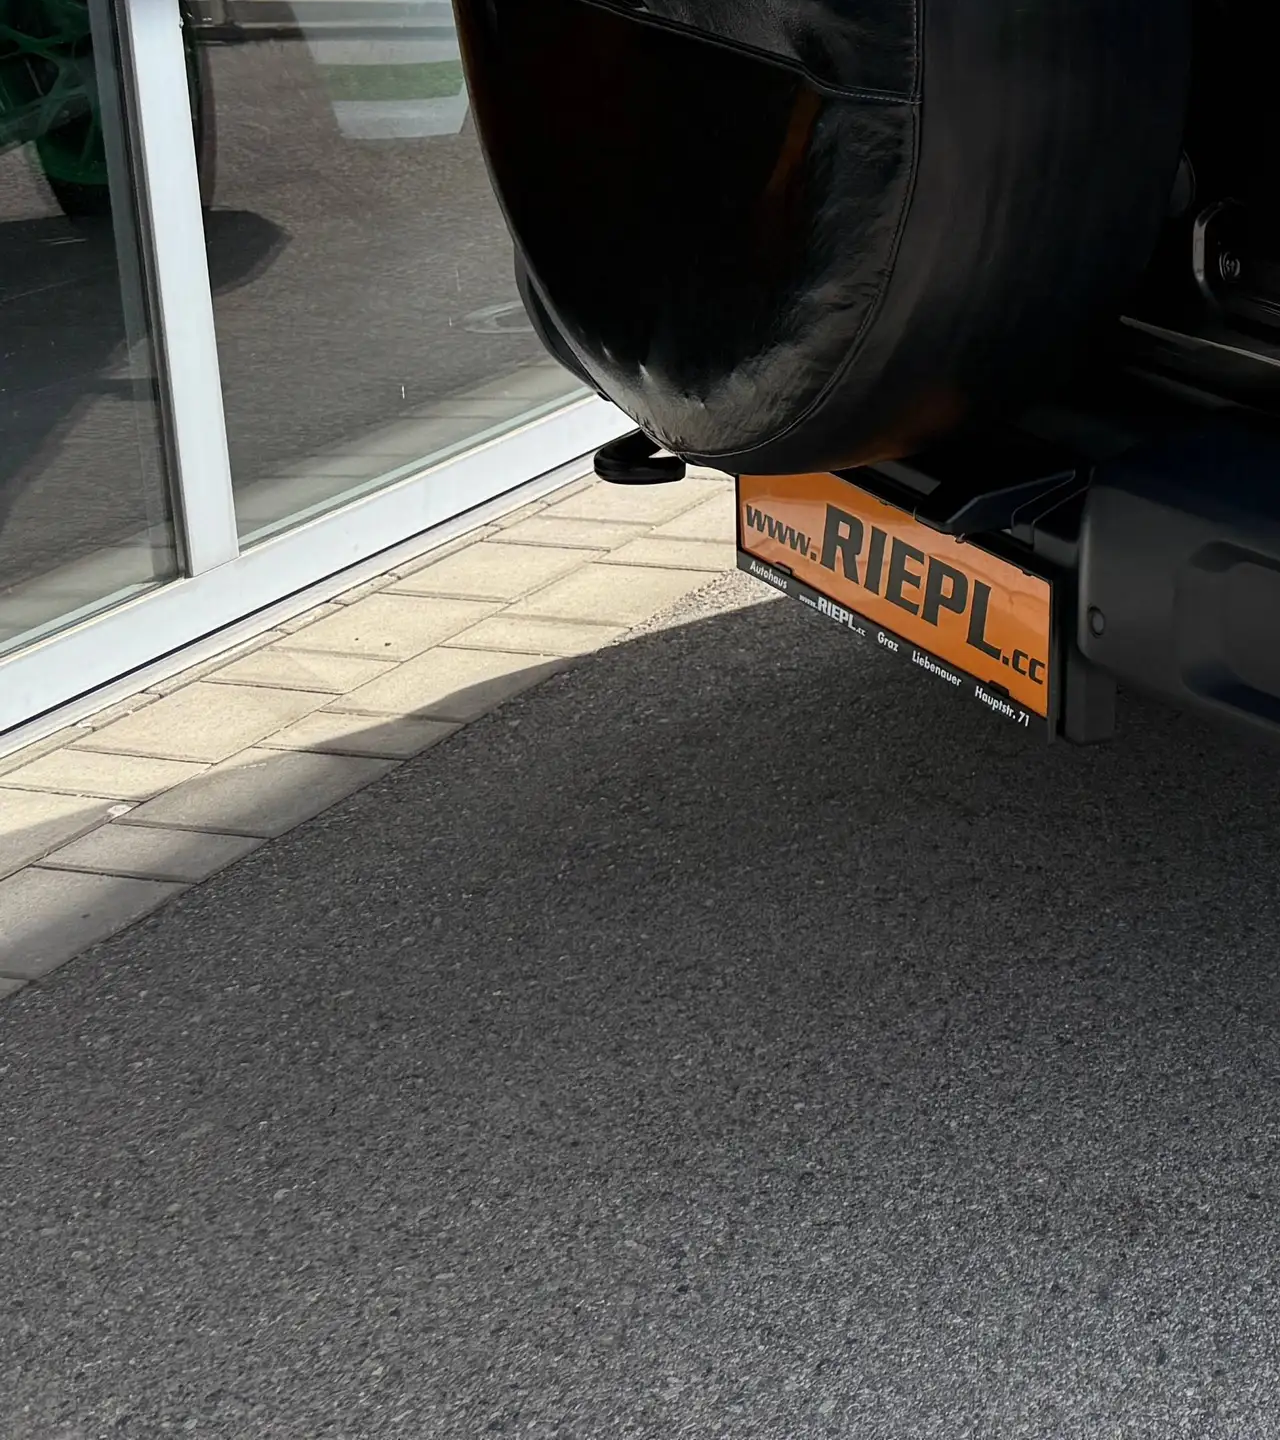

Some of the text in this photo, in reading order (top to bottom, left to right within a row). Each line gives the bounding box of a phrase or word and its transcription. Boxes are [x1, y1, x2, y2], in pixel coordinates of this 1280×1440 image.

[745, 502, 1046, 685] www.RIEPL.cc
[749, 560, 788, 590] Autohaus
[877, 630, 899, 653] Graz
[911, 650, 962, 687] Liebenauer
[974, 685, 1016, 720] Hauptstr.
[1017, 711, 1030, 727] 71
